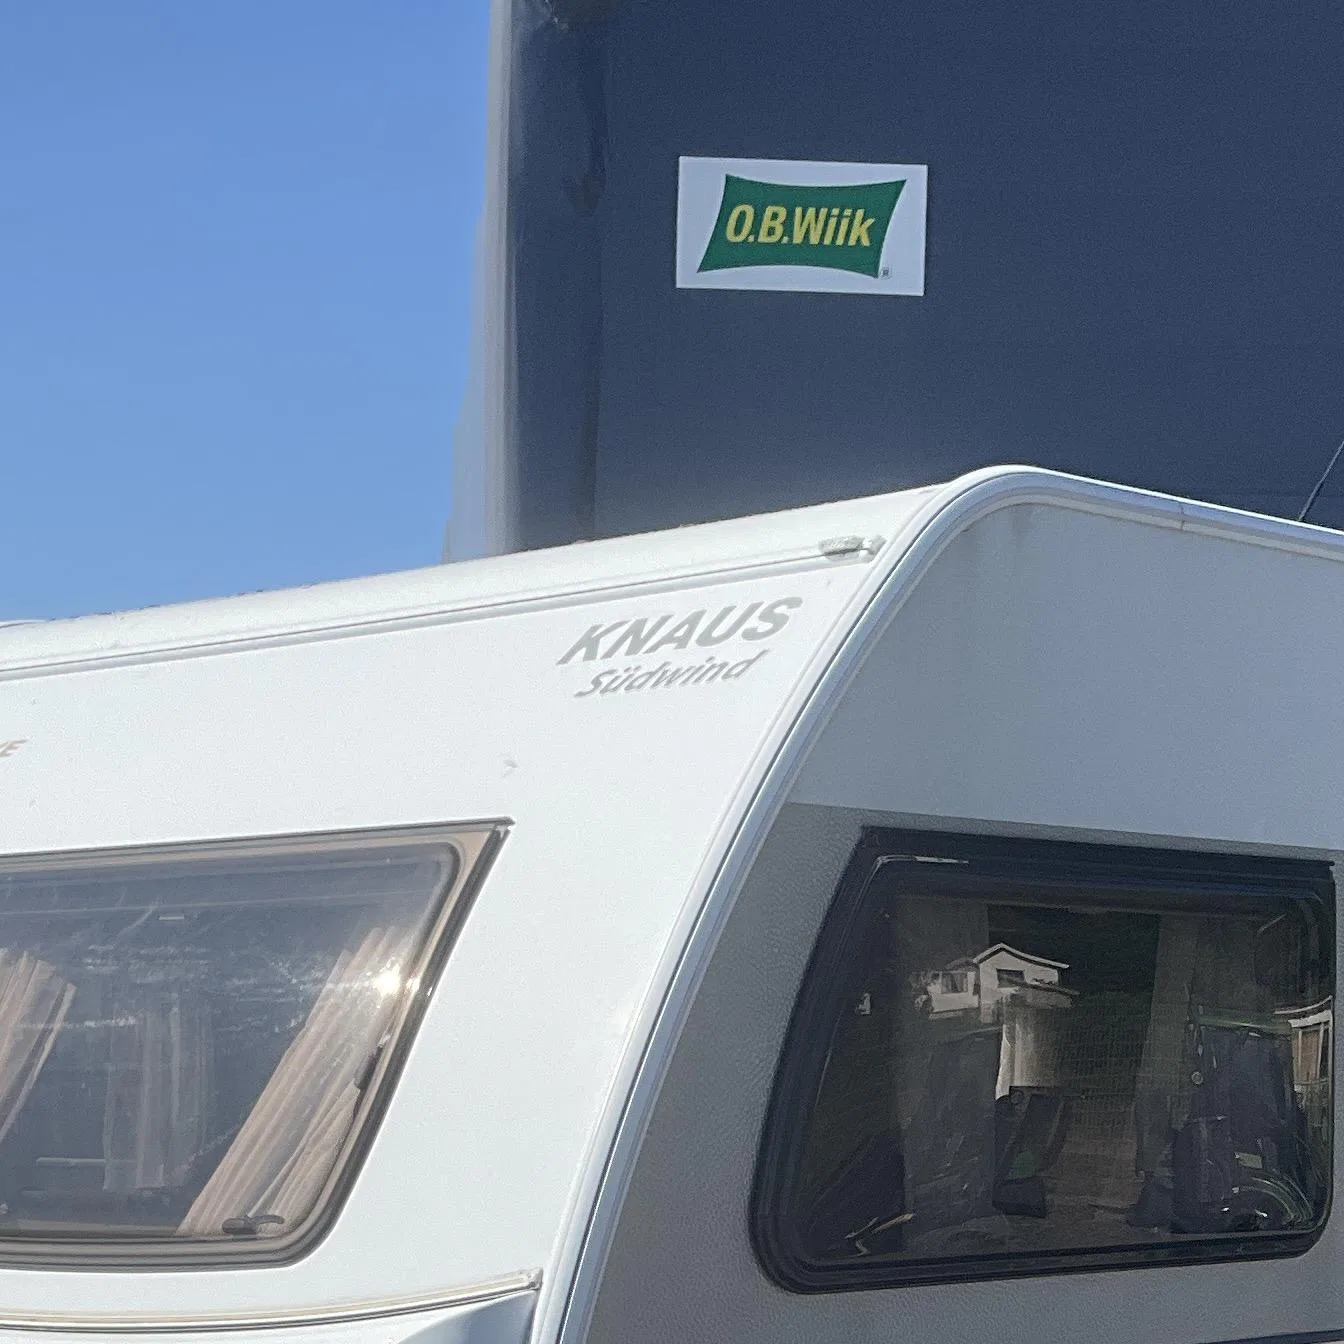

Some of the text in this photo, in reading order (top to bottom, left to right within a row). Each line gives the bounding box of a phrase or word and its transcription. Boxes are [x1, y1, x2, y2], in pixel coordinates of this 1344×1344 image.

[725, 203, 876, 247] O.B.Wiik
[556, 597, 803, 665] KNAUS
[573, 649, 770, 698] Südwind
